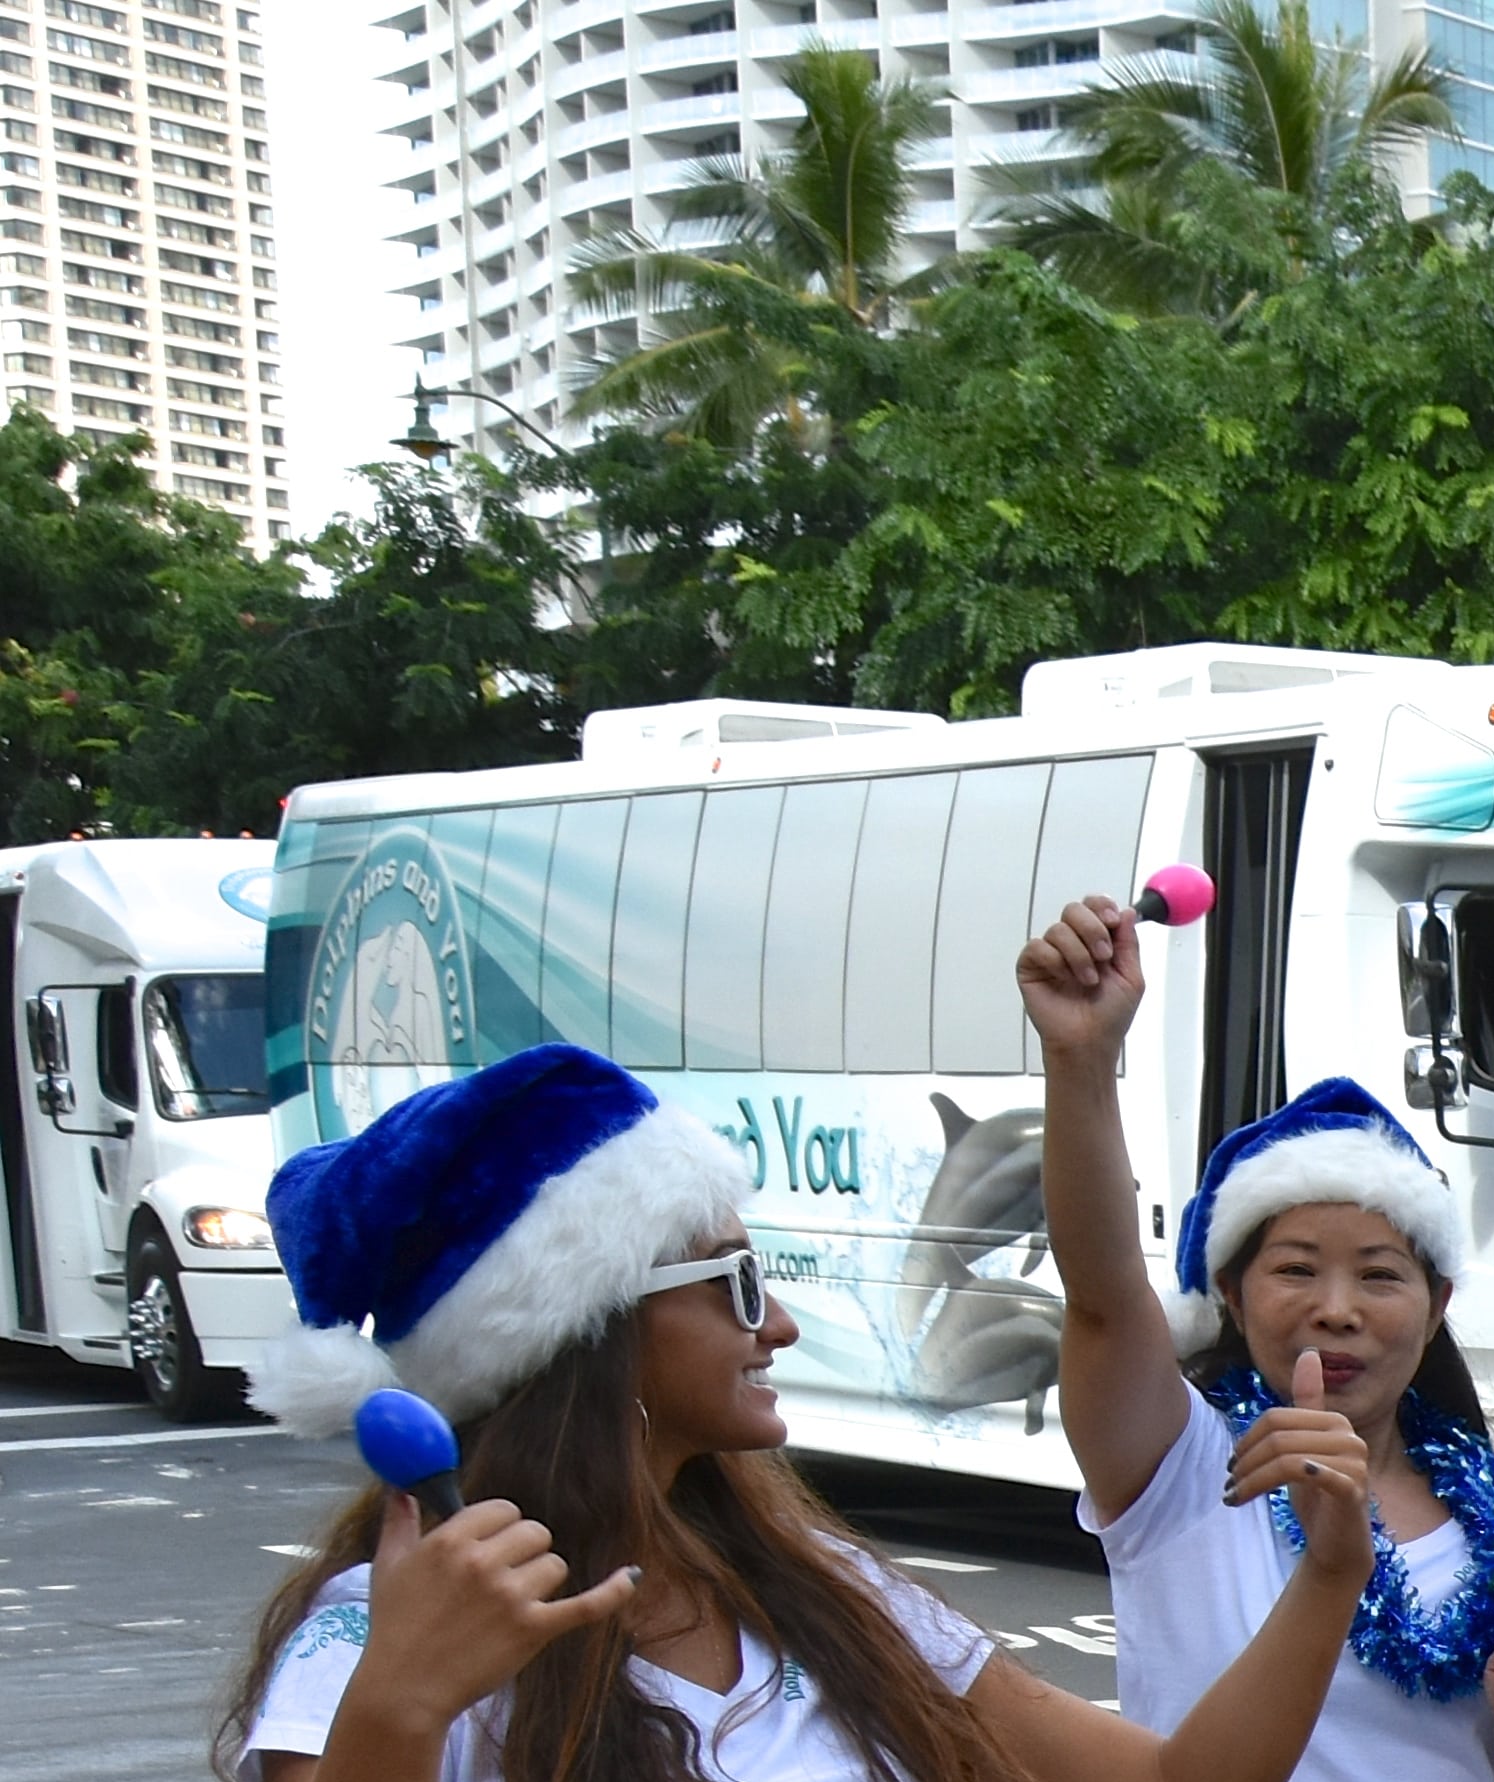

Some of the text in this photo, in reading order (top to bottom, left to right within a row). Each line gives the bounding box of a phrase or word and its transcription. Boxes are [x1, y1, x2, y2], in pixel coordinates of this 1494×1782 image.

[312, 857, 464, 1043] Dolphins and You
[772, 1095, 861, 1195] You
